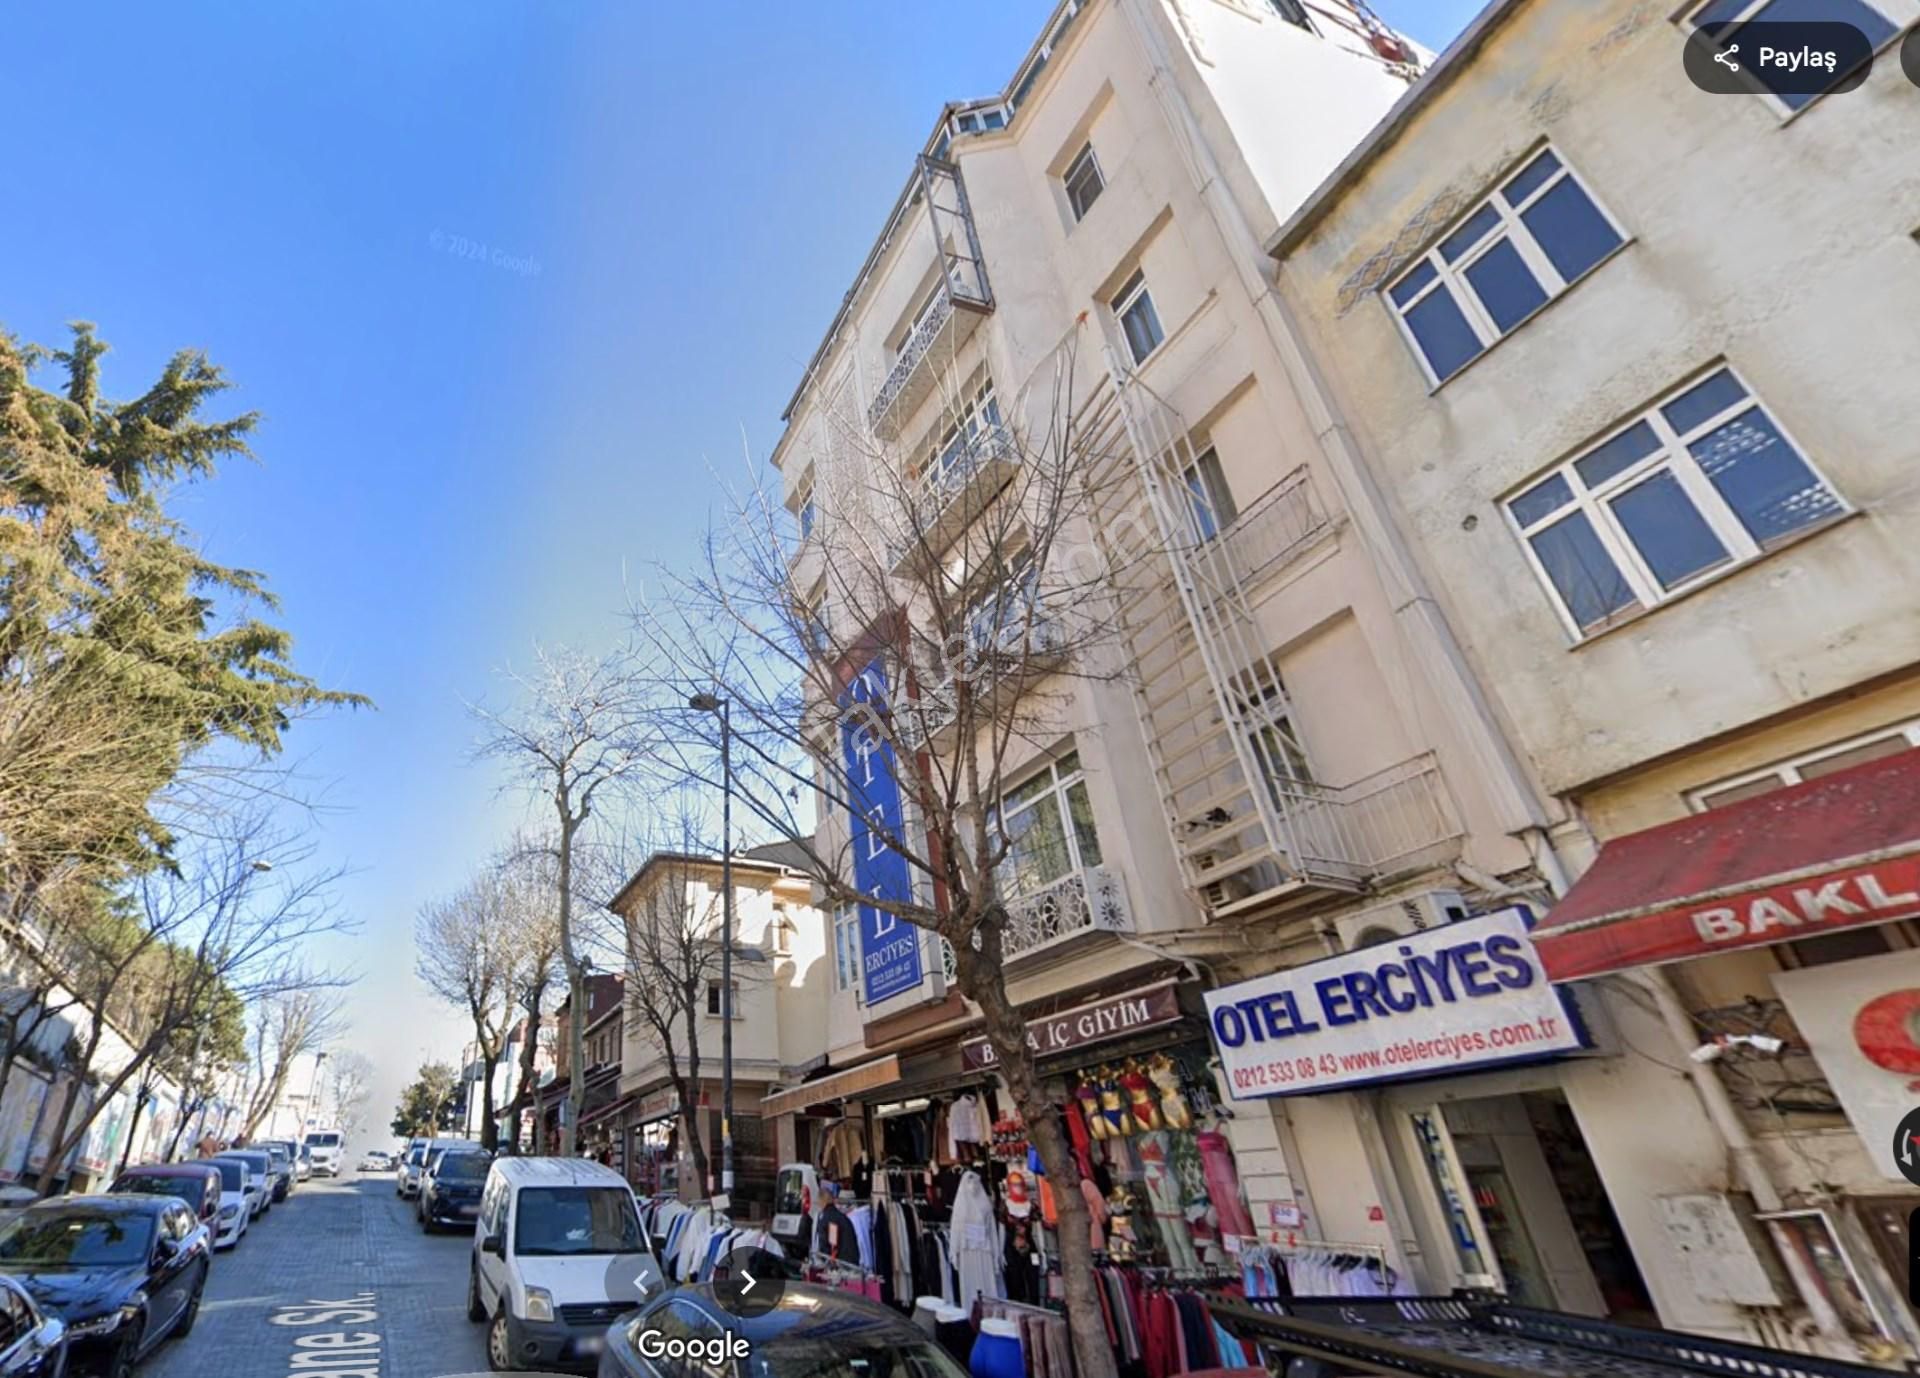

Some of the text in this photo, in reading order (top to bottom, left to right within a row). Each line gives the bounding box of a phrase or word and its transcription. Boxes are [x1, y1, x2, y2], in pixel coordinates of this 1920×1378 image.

[1691, 873, 1920, 944] BAKL
[865, 934, 914, 973] ERCİYES
[1048, 1022, 1071, 1046] İÇ
[1077, 999, 1150, 1038] GİYİM
[1213, 934, 1534, 1047] OTEL ERCİYES
[1233, 1065, 1268, 1089] 0212
[1269, 1062, 1295, 1084] 533
[1319, 1053, 1338, 1076] 43
[1339, 1016, 1558, 1072] www.otelerciyes.com.tr
